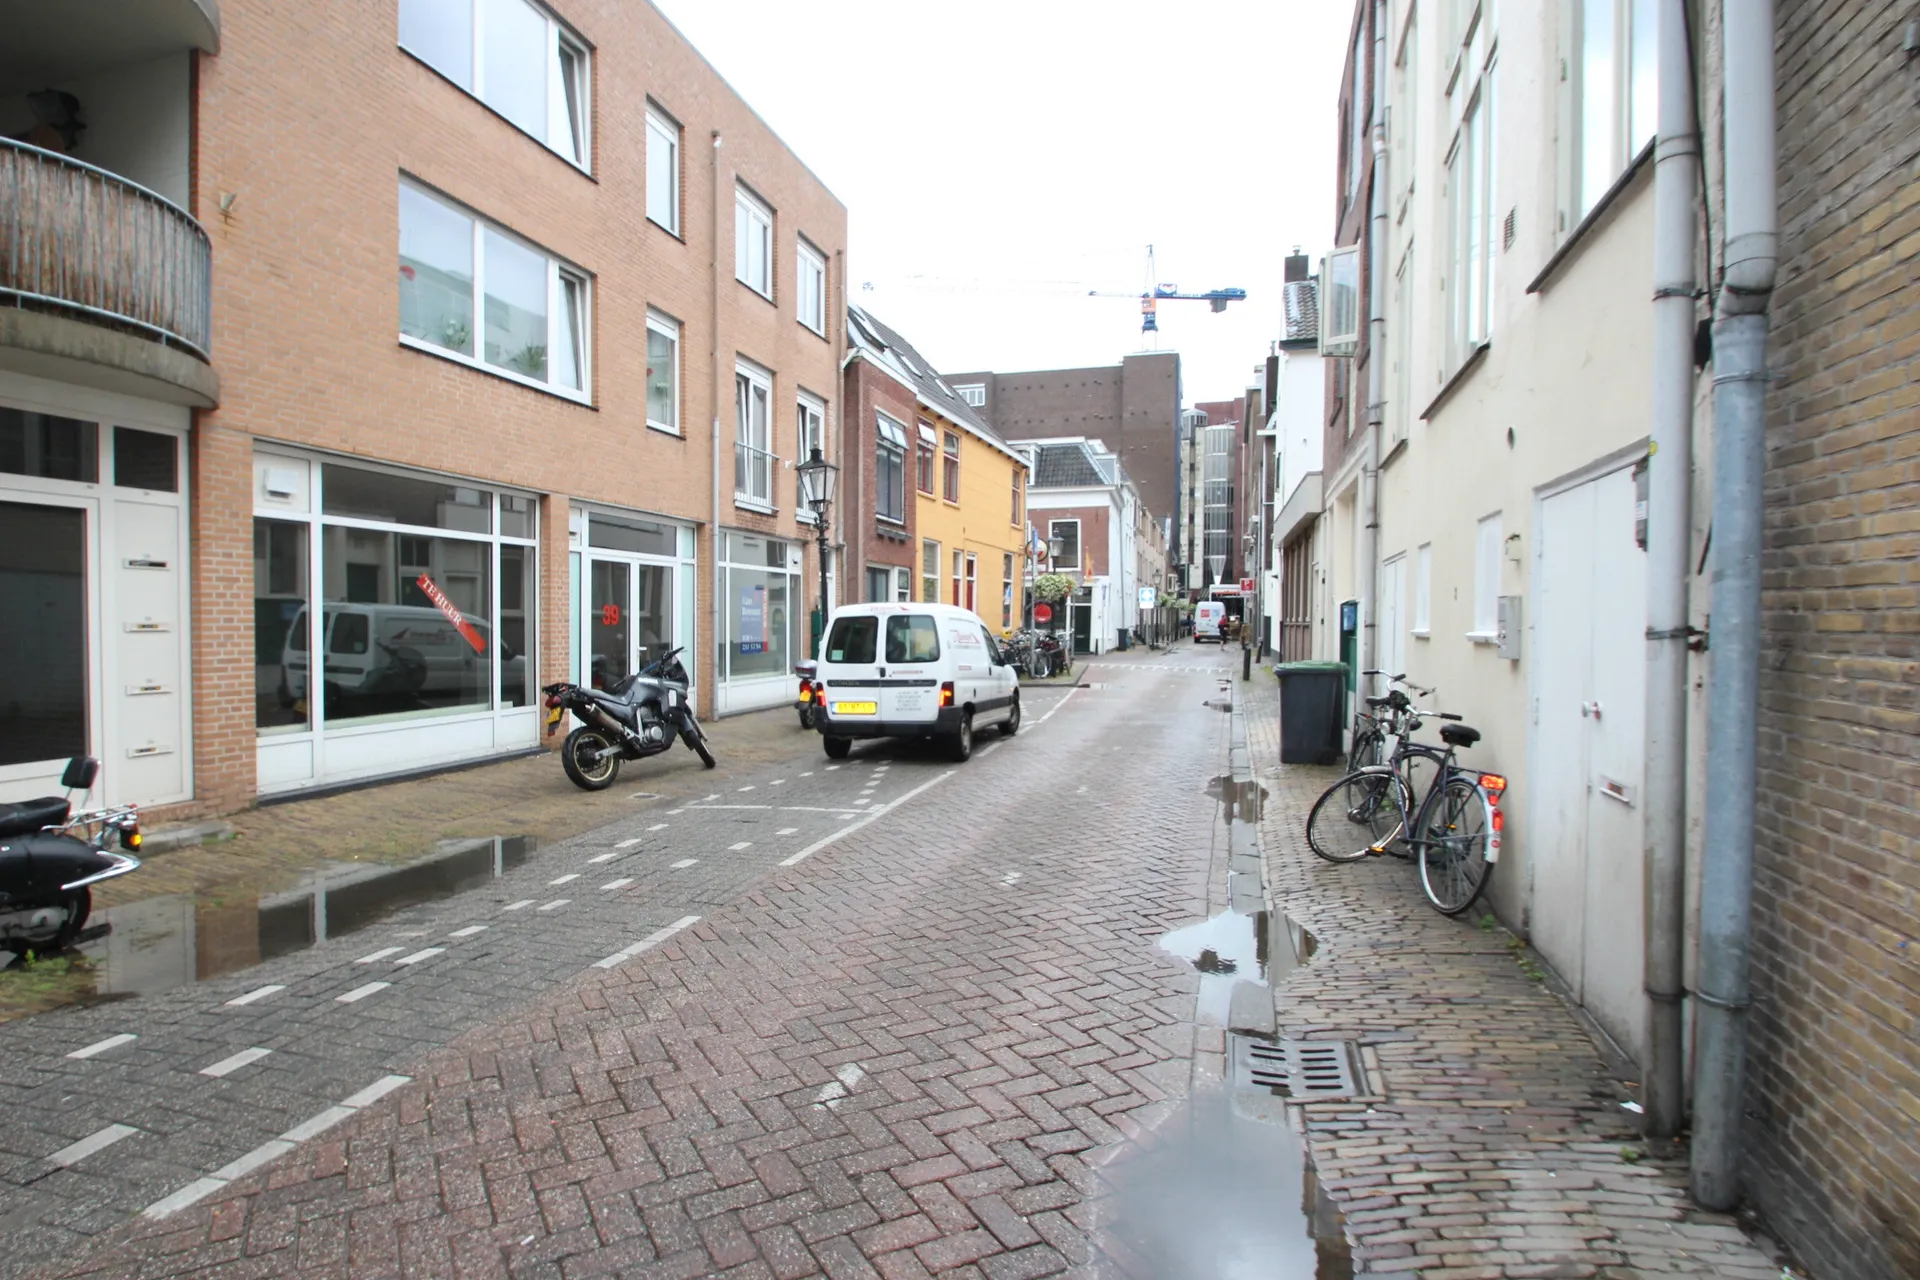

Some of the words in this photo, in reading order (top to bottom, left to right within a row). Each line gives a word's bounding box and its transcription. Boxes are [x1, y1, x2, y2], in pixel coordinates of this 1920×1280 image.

[422, 577, 437, 597] TE
[434, 592, 462, 627] HUUR
[602, 604, 619, 625] 39
